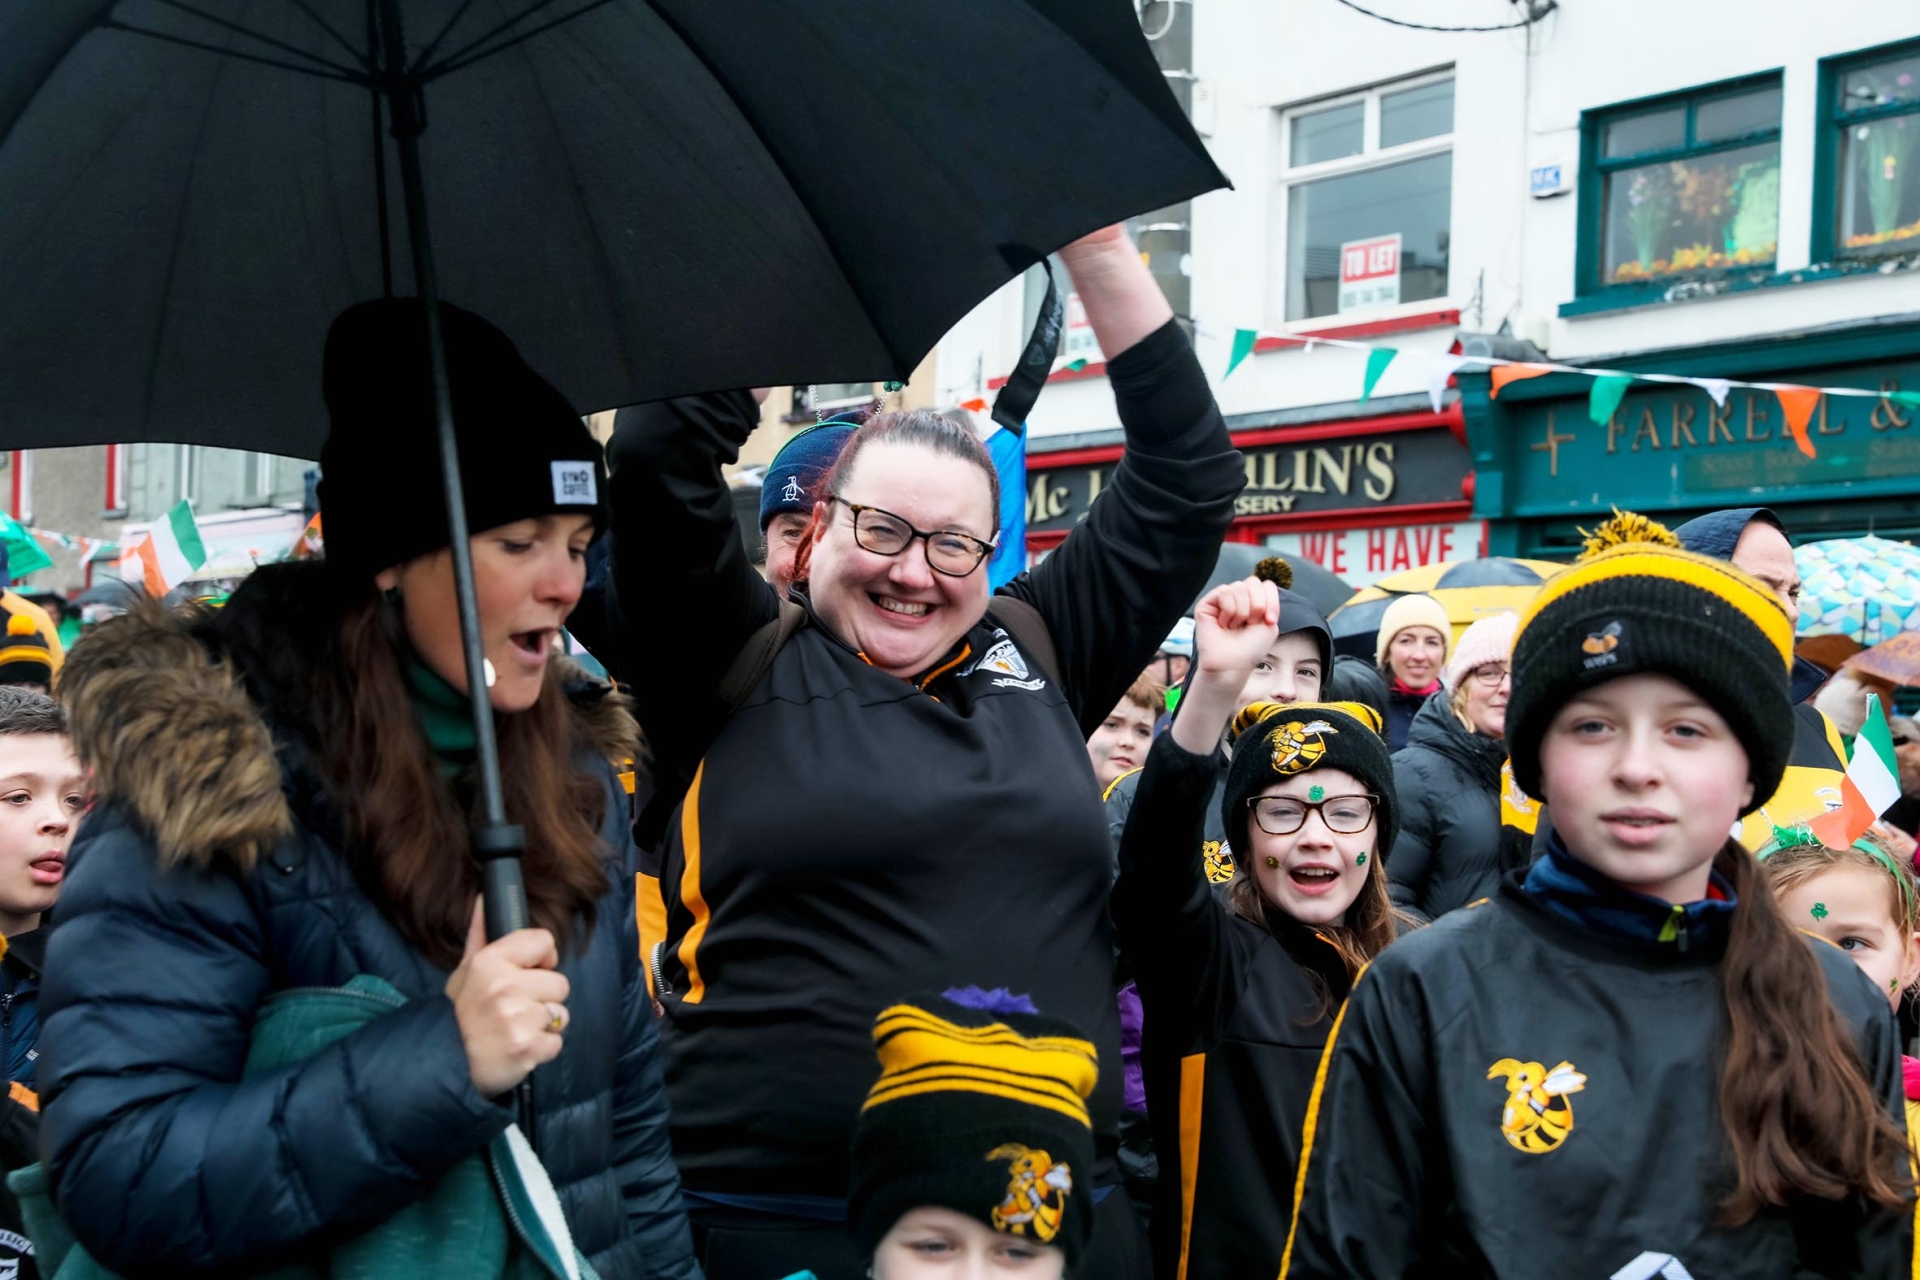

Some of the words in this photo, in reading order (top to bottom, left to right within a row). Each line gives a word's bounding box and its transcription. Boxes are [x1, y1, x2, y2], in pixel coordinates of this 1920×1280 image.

[1345, 249, 1365, 278] TO
[1368, 243, 1396, 274] LET
[1301, 533, 1347, 573] WE
[1366, 526, 1454, 573] HAVE
